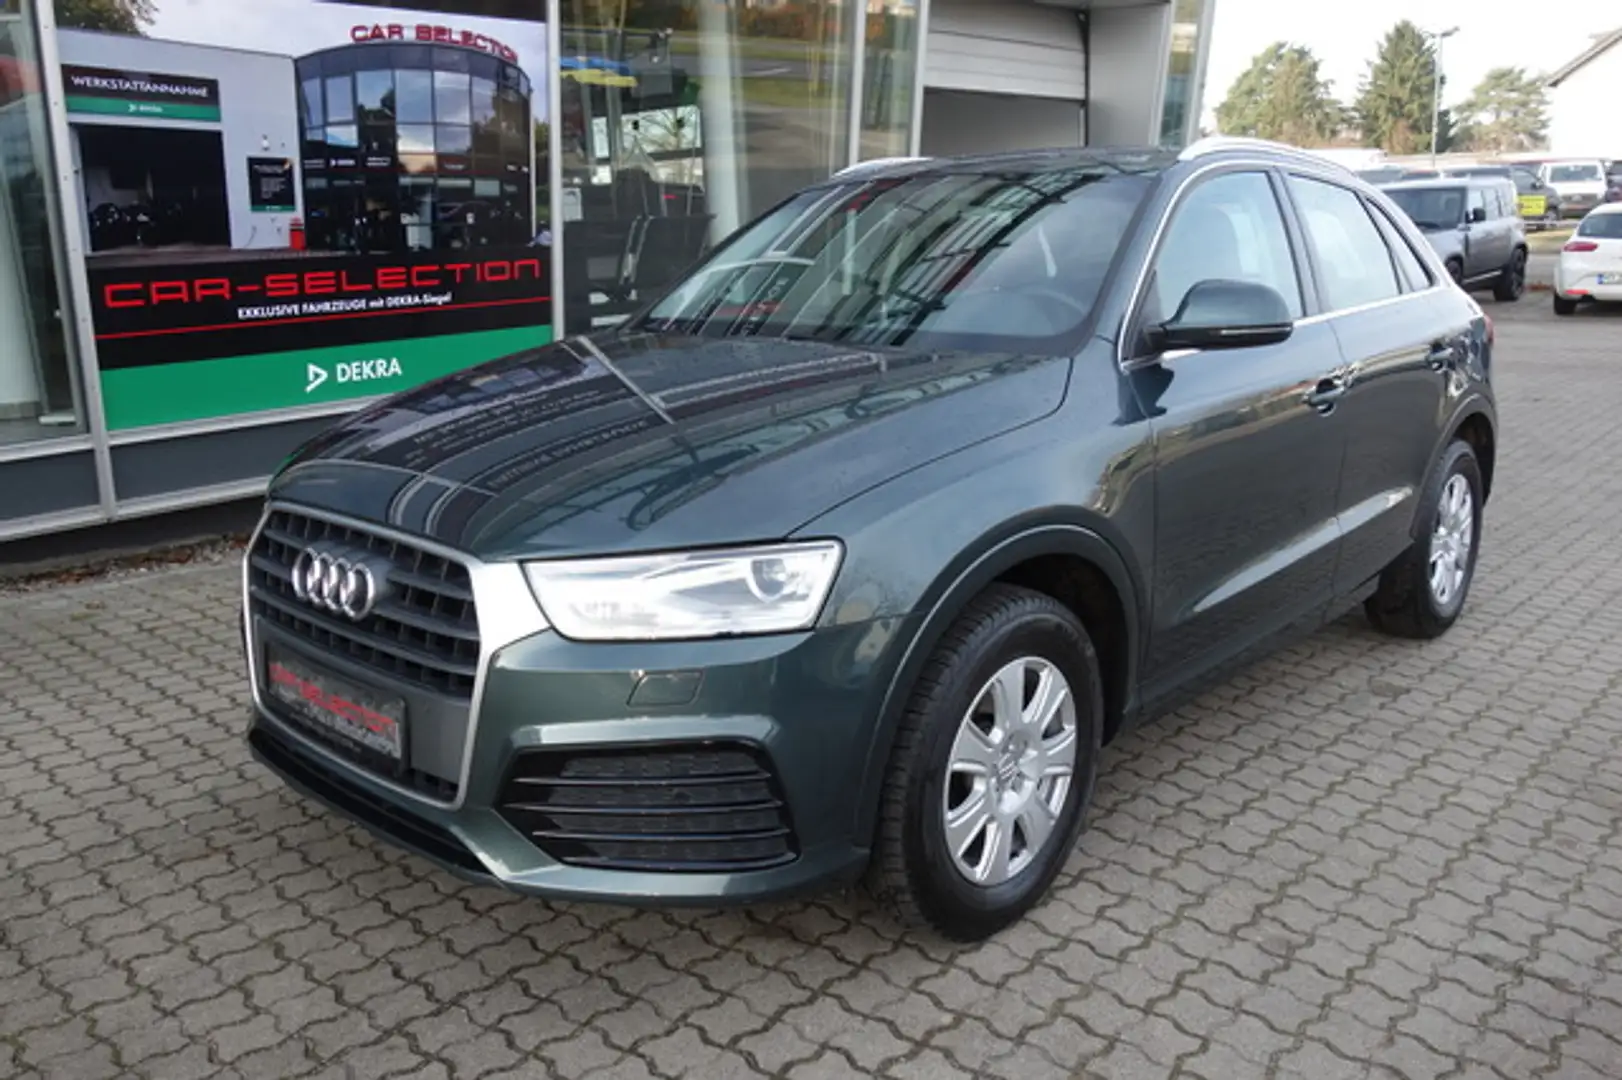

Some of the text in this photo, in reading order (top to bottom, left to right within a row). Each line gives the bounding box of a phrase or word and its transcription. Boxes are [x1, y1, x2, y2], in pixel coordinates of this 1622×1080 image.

[350, 23, 404, 42] CAR
[71, 75, 208, 97] WERKSTATTANNAHME
[104, 258, 540, 308] CAR-SELECTION
[237, 304, 300, 319] EXKLUSIVE
[302, 299, 366, 314] FAHRZEUGE
[369, 297, 384, 309] mit
[336, 357, 403, 382] DEKRA
